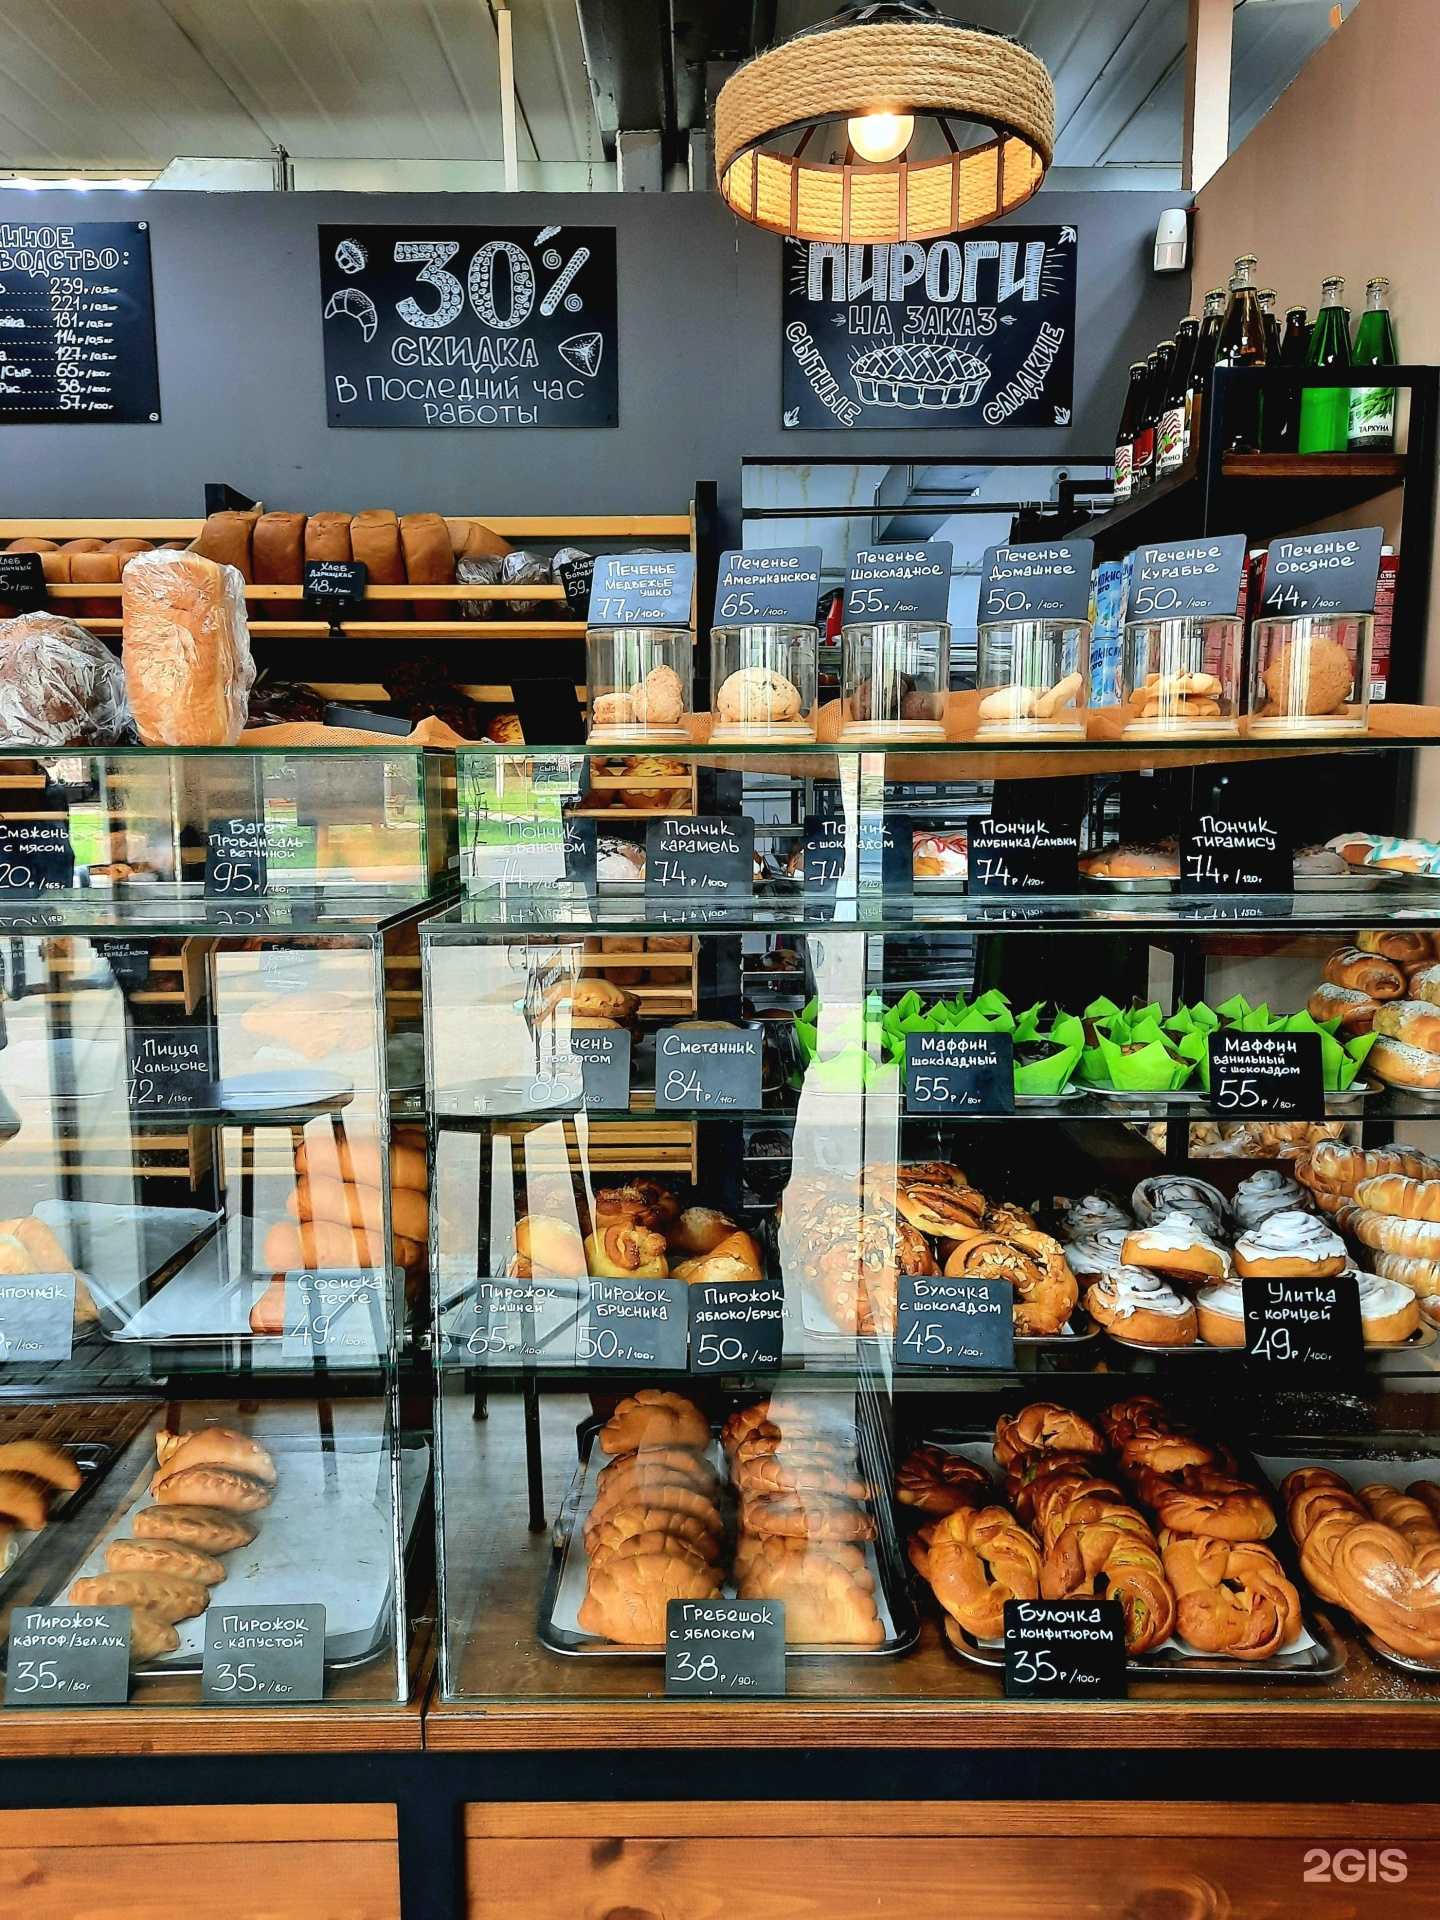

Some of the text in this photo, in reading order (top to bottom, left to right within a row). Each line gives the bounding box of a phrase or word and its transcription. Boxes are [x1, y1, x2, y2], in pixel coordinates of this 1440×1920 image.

[0, 225, 74, 249] ННОЕ
[808, 240, 1046, 303] ПИРОГИ
[393, 240, 590, 329] 30%
[849, 305, 998, 336] НА ЗАКАЗ
[392, 336, 539, 374] СКИДКА
[786, 322, 862, 427] СЫТНЫЕ
[982, 322, 1065, 425] СЛАДКИЕ
[335, 375, 358, 402] В
[533, 380, 585, 401] час
[857, 551, 927, 564] Печенье
[996, 548, 1072, 562] Печенье
[1145, 546, 1221, 563] Печенье
[1280, 541, 1360, 558] Печенье
[731, 555, 799, 570] Печенье
[1275, 556, 1355, 573] Овсяное
[723, 572, 817, 586] Американское
[851, 564, 943, 580] Шоколадное
[989, 565, 1076, 581] Домашнее
[1141, 563, 1219, 580] Курабье
[0, 825, 69, 839] Смажень
[228, 819, 287, 834] Багет
[507, 822, 581, 841] Пончик
[664, 820, 735, 836] Пончик
[980, 819, 1050, 835] Пончик
[1200, 816, 1277, 834] Пончик
[3, 844, 64, 854] с мясом
[209, 834, 304, 848] Провансаль
[660, 839, 740, 854] карамель
[807, 842, 816, 850] с
[1192, 836, 1276, 851] тирамису
[216, 848, 296, 858] с ветчиной
[142, 1039, 199, 1058] Пицца
[663, 1035, 756, 1055] Сметанник
[921, 1038, 987, 1055] Маффин
[1225, 1037, 1297, 1054] Маффин
[132, 1058, 208, 1074] Кальцоне
[911, 1052, 997, 1068] шоколадный
[1213, 1054, 1285, 1065] ванильный
[1231, 1066, 1300, 1077] шоколадом
[298, 1274, 383, 1290] Сосиска
[913, 1280, 989, 1300] Булочка
[302, 1293, 372, 1305] в тесте
[480, 1283, 558, 1299] Пирожок
[589, 1281, 672, 1302] Пирожок
[704, 1288, 786, 1304] Пирожок
[1268, 1282, 1336, 1303] Улитка
[473, 1300, 545, 1314] с вишней
[899, 1301, 1001, 1315] с шоколадом
[1248, 1305, 1332, 1323] с корицей
[25, 1610, 110, 1630] Пирожок
[683, 1604, 774, 1625] Гребешок
[1017, 1602, 1101, 1623] Булочка
[222, 1615, 309, 1633] Пирожок
[214, 1634, 304, 1649] с капустой
[670, 1628, 755, 1641] с яблоком
[1006, 1628, 1113, 1641] с конфитюром
